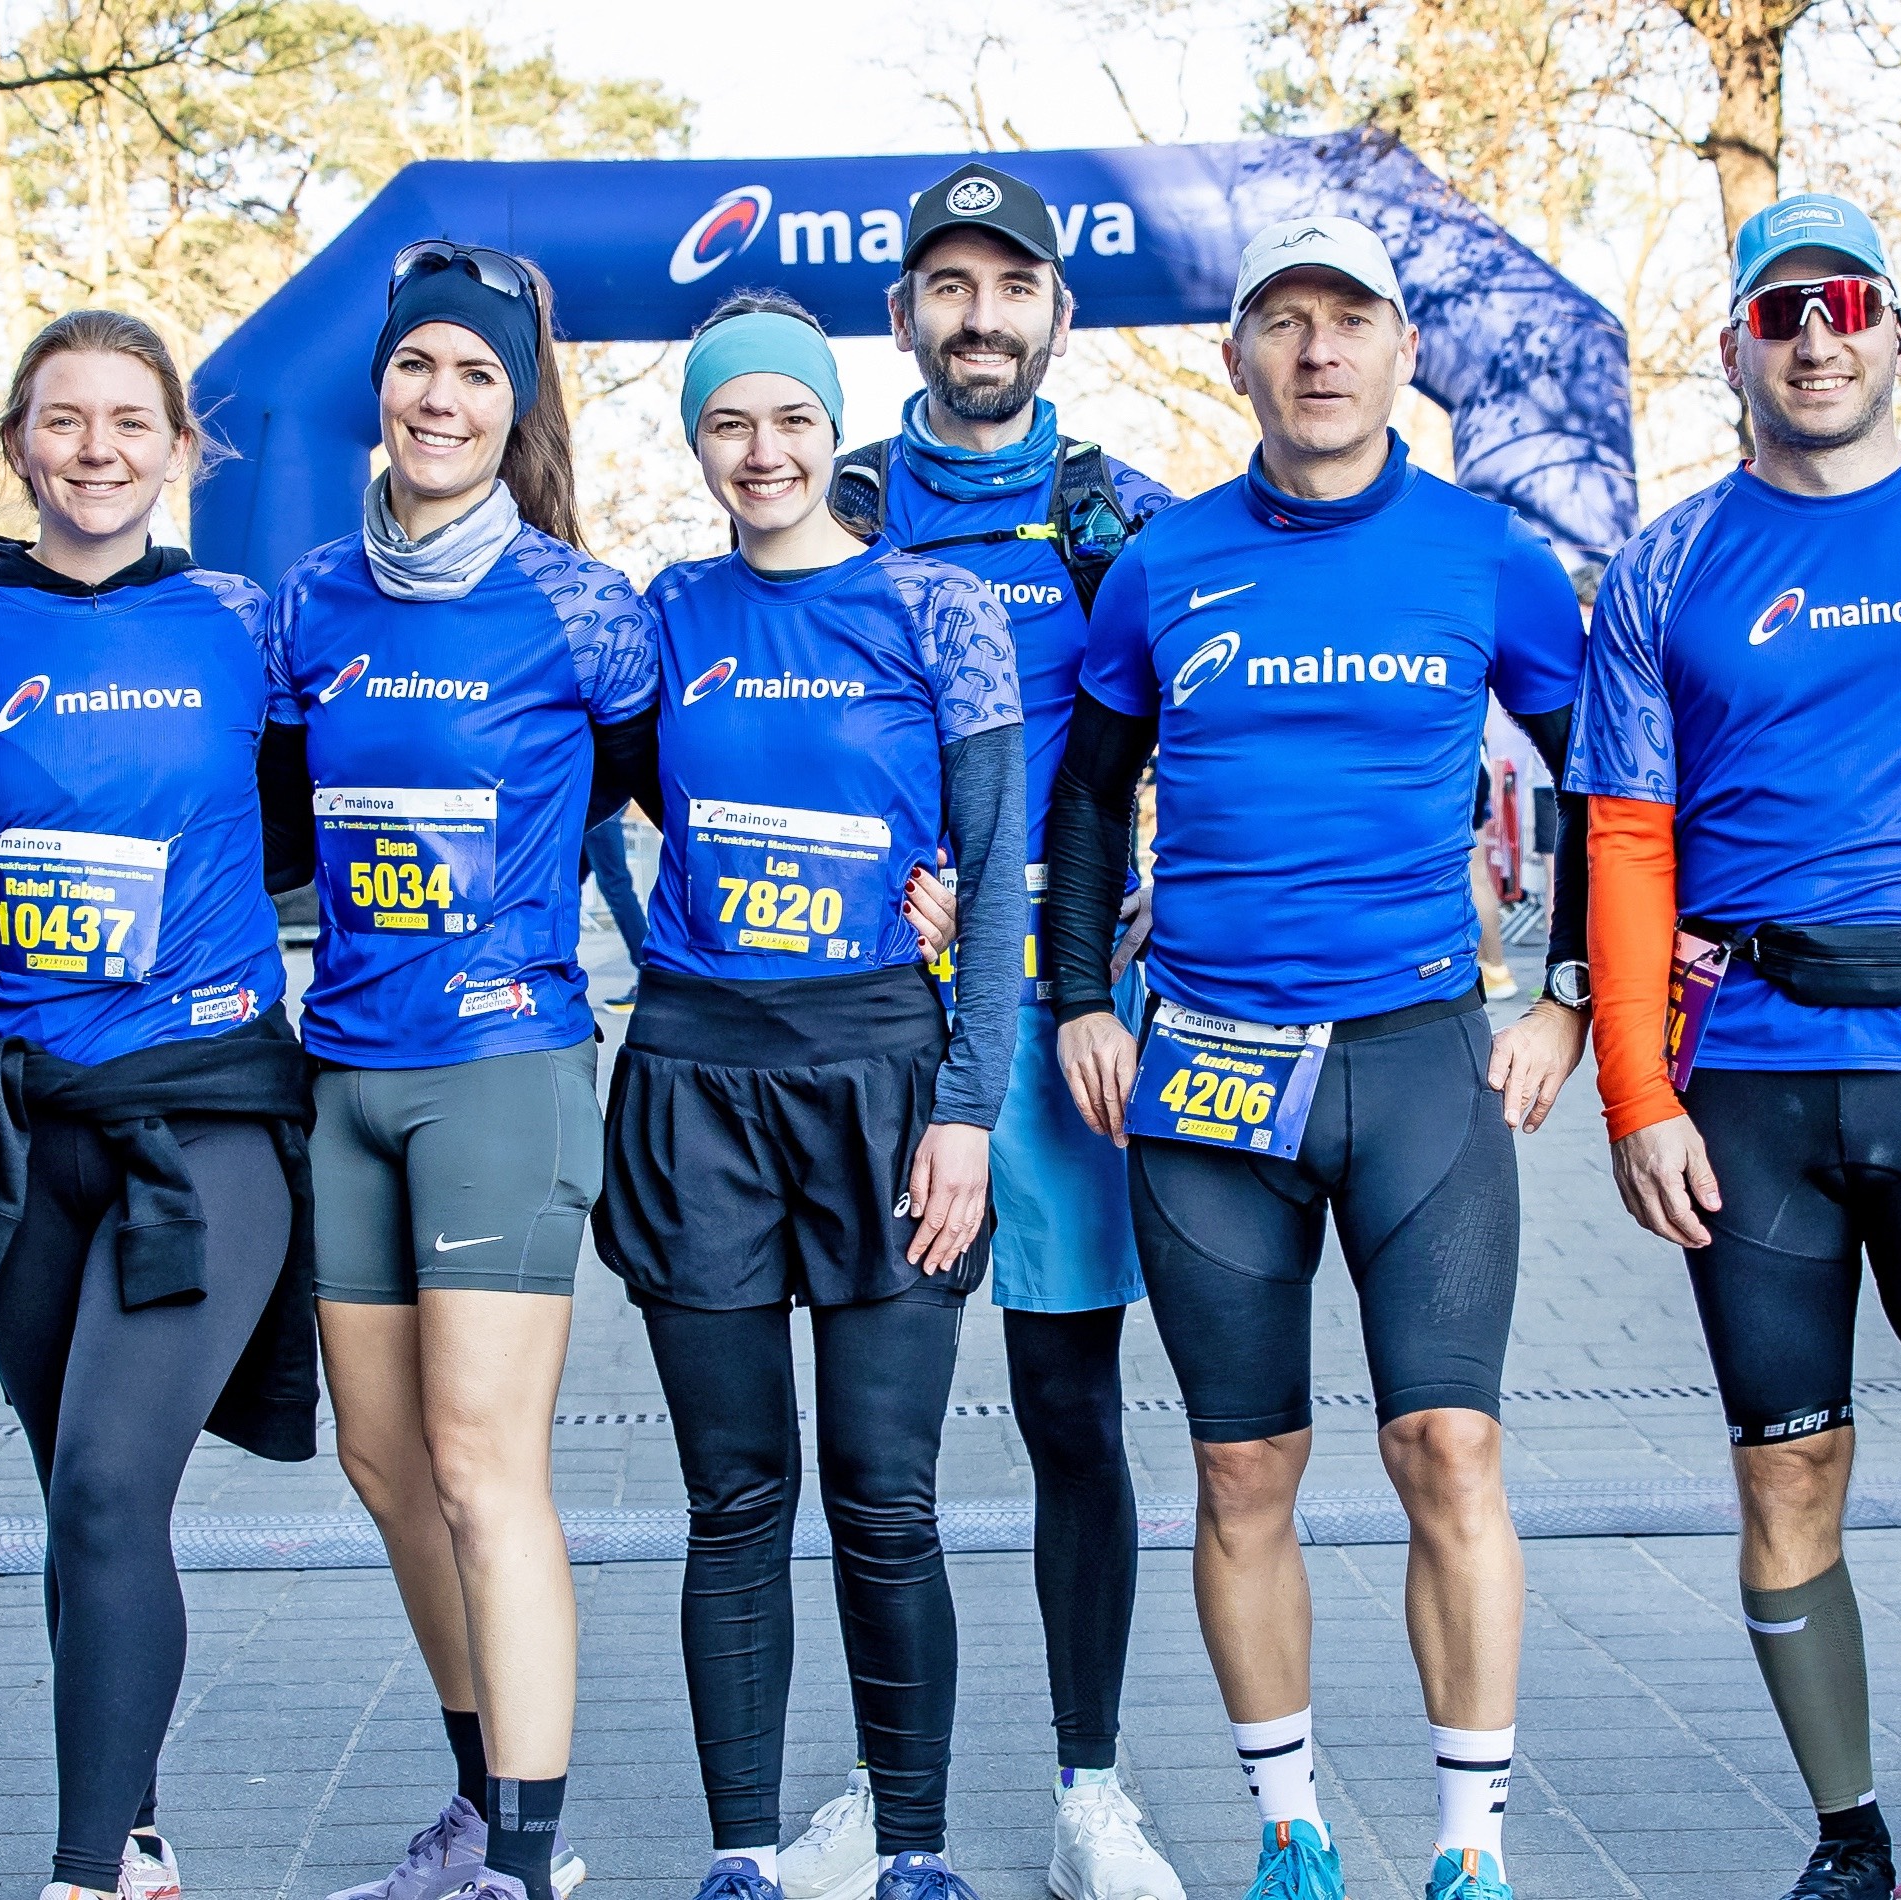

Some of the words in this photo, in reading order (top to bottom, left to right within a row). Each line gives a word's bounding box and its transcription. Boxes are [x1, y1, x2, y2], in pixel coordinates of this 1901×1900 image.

[778, 192, 1135, 265] mava
[1247, 646, 1447, 686] mainova
[365, 670, 489, 701] mainova
[734, 671, 865, 698] mainova
[55, 683, 202, 714] mainova
[344, 796, 394, 810] mainova
[416, 822, 485, 833] Halbmarathon
[725, 812, 788, 828] mainova
[1, 837, 61, 851] mainova
[376, 838, 417, 857] Elena
[713, 834, 765, 849] Frankfurter
[767, 840, 808, 854] Mainova
[810, 845, 879, 861] Halbmarathon
[766, 856, 800, 878] Lea
[5, 877, 54, 897] Rahel
[59, 880, 115, 902] Tabea
[350, 862, 453, 909] 5034
[718, 876, 843, 935] 7820
[197, 998, 238, 1013] energie
[465, 998, 511, 1012] akademie
[1185, 1013, 1236, 1033] mainova
[1192, 1052, 1265, 1076] Andreas
[1159, 1069, 1277, 1124] 4206
[1788, 1409, 1829, 1434] cep
